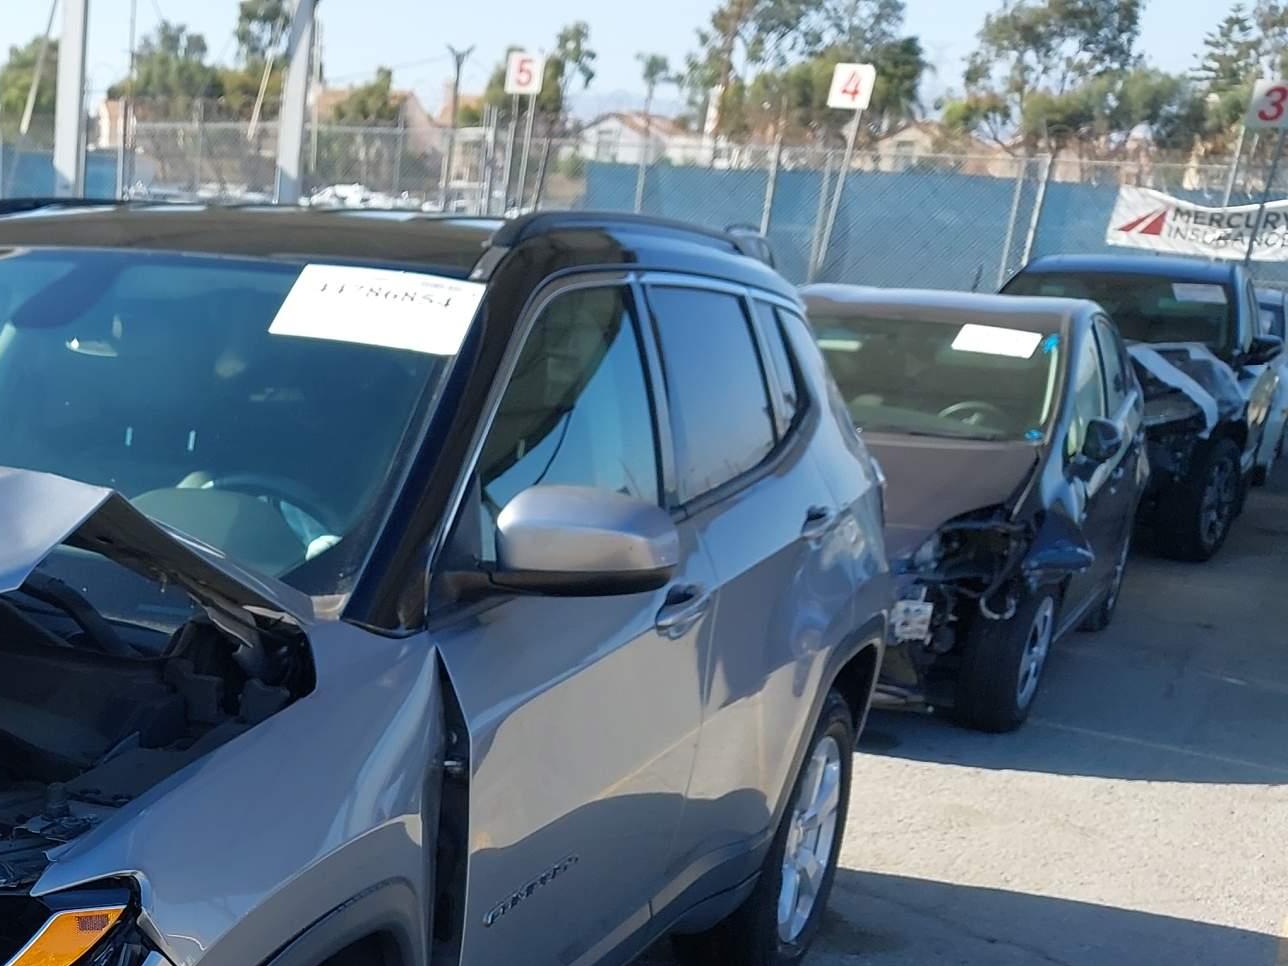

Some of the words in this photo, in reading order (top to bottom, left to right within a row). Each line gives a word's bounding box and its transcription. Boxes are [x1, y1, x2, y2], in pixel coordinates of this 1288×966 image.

[516, 58, 533, 87] 5
[842, 70, 862, 101] 4
[1257, 86, 1288, 121] 3
